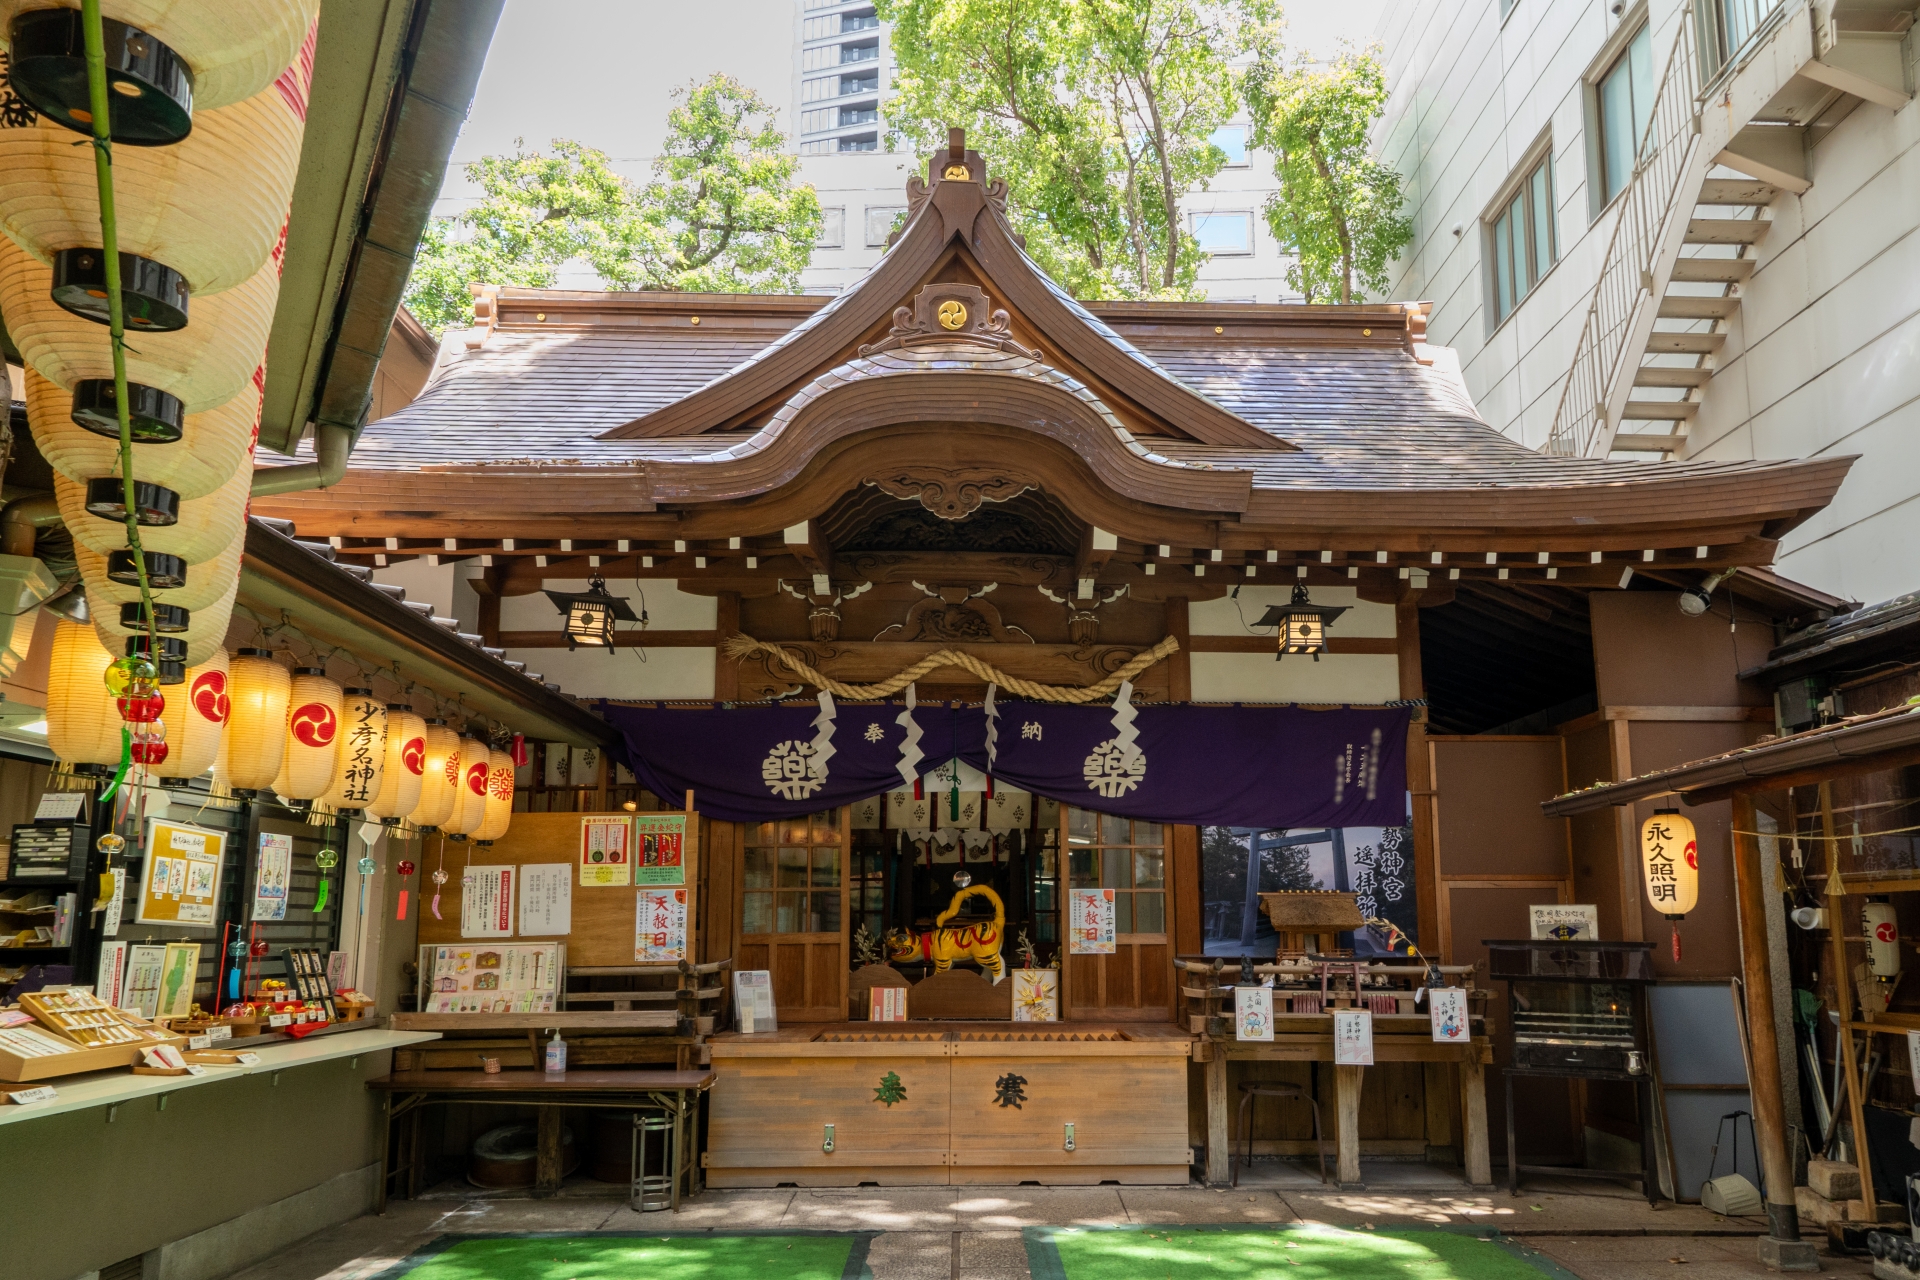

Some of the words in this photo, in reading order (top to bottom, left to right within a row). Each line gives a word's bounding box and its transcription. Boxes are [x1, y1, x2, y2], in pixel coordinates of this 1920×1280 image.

[344, 702, 379, 801] 少彦名神社
[864, 722, 885, 744] 奉
[1021, 721, 1042, 742] 納
[1647, 823, 1677, 901] 永久照明
[653, 895, 669, 948] 天赦日
[1085, 894, 1099, 942] 天赦日
